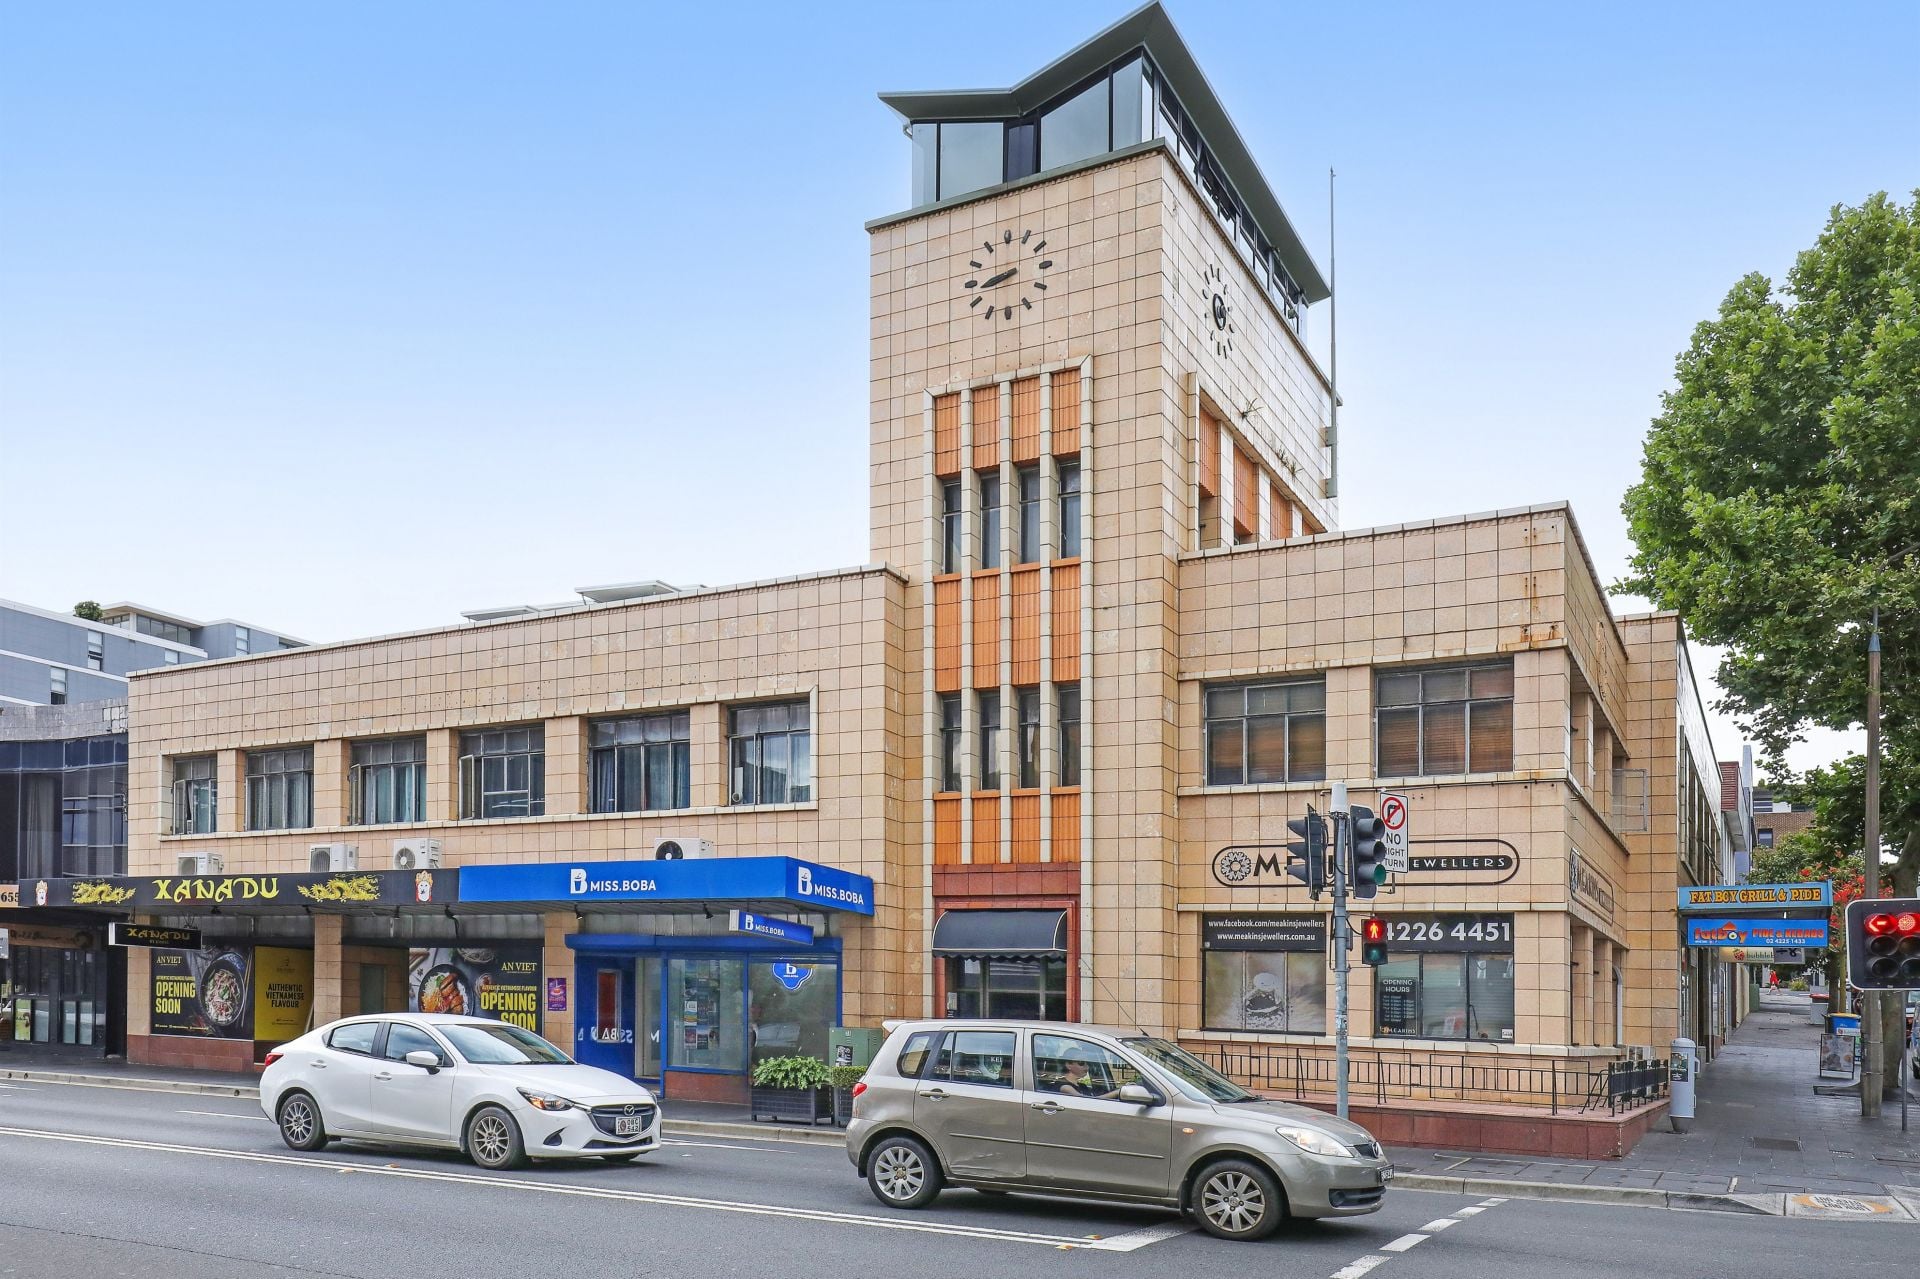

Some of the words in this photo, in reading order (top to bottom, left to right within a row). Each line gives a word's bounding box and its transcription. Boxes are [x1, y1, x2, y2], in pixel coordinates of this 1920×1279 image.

[1386, 832, 1401, 845] NO
[1384, 858, 1405, 868] TURN
[1413, 857, 1505, 868] EWELLERS
[152, 877, 280, 903] XANADU
[590, 879, 657, 892] MISS.BOBA
[814, 885, 864, 905] MISS.BOBA
[1689, 889, 1713, 904] FAT
[1713, 889, 1739, 903] BOY
[1739, 889, 1777, 903] GRILL
[1778, 888, 1788, 902] &
[1789, 888, 1822, 902] PIDE
[755, 924, 785, 937] MISS.BOBA
[1208, 919, 1325, 929] www.facebook.com/meakinsjewellers
[126, 928, 190, 940] XANADU
[1217, 932, 1316, 942] www.meakinsjewellers.com.au
[1386, 922, 1444, 941] 4226
[1450, 922, 1510, 941] 4451
[156, 955, 168, 963] AN
[168, 956, 183, 964] VIET
[501, 962, 514, 971] AN
[515, 962, 538, 971] VIET
[156, 981, 196, 998] OPENING
[268, 984, 303, 992] AUTHENTIC
[266, 992, 304, 1000] VIETNAMESE
[480, 992, 537, 1011] OPENING
[155, 998, 181, 1014] SOON
[271, 1000, 300, 1008] FLAVOUR
[501, 1012, 536, 1032] SOON
